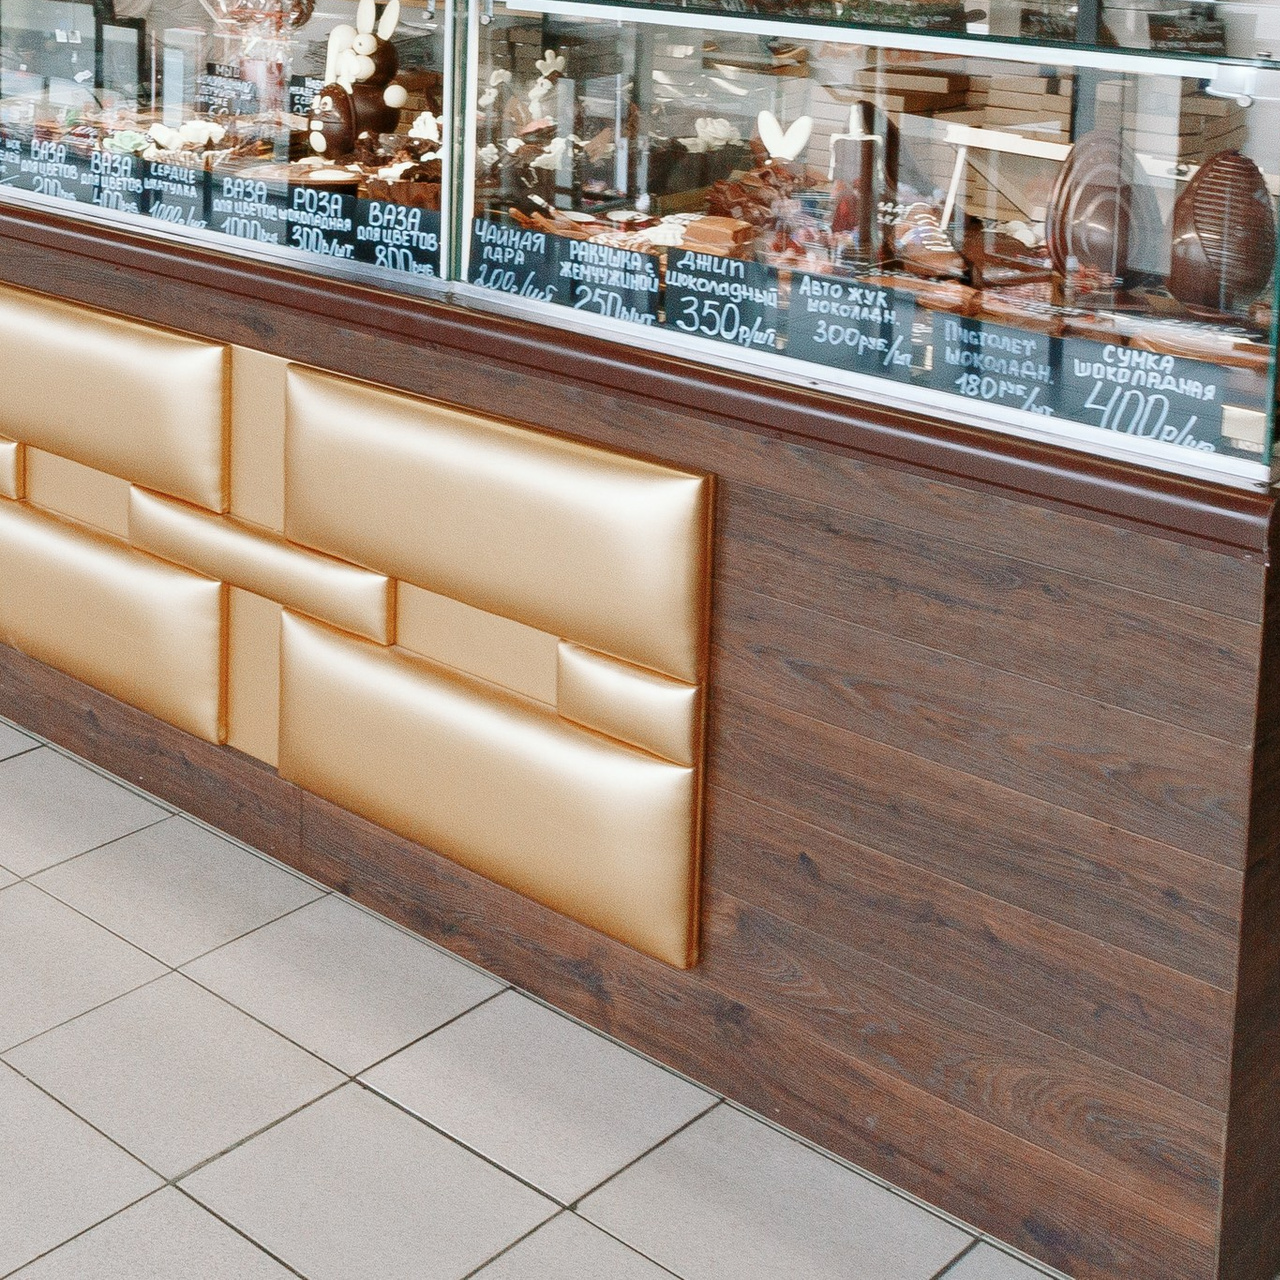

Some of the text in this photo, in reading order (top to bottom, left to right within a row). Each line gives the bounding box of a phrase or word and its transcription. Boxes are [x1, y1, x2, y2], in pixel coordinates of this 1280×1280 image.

[30, 138, 67, 164] ВАЗА
[90, 150, 132, 178] ВАЗА
[38, 162, 79, 181] ЦВЕТОВ
[100, 177, 144, 194] ЦВЕТОВ
[150, 162, 197, 185] СЕРДЦЕ
[222, 176, 268, 205] ВАЗА
[293, 187, 343, 218] РОЗА
[277, 208, 353, 233] ШОКОЛАДНАЯ
[368, 201, 422, 232] ВАЗА
[382, 228, 440, 252] ЦВЕТОВ
[473, 219, 546, 255] ЧАЙНАЯ
[483, 245, 526, 265] ПАРА
[570, 240, 643, 271] РАКУШКА
[676, 251, 745, 280] ДЖИП
[559, 260, 660, 293] ЖЕМЧУЖИНОЙ
[847, 287, 889, 309] ЖУК
[1102, 343, 1176, 374] СУМКА
[1073, 358, 1217, 402] ШОКОЛАДНАЯ
